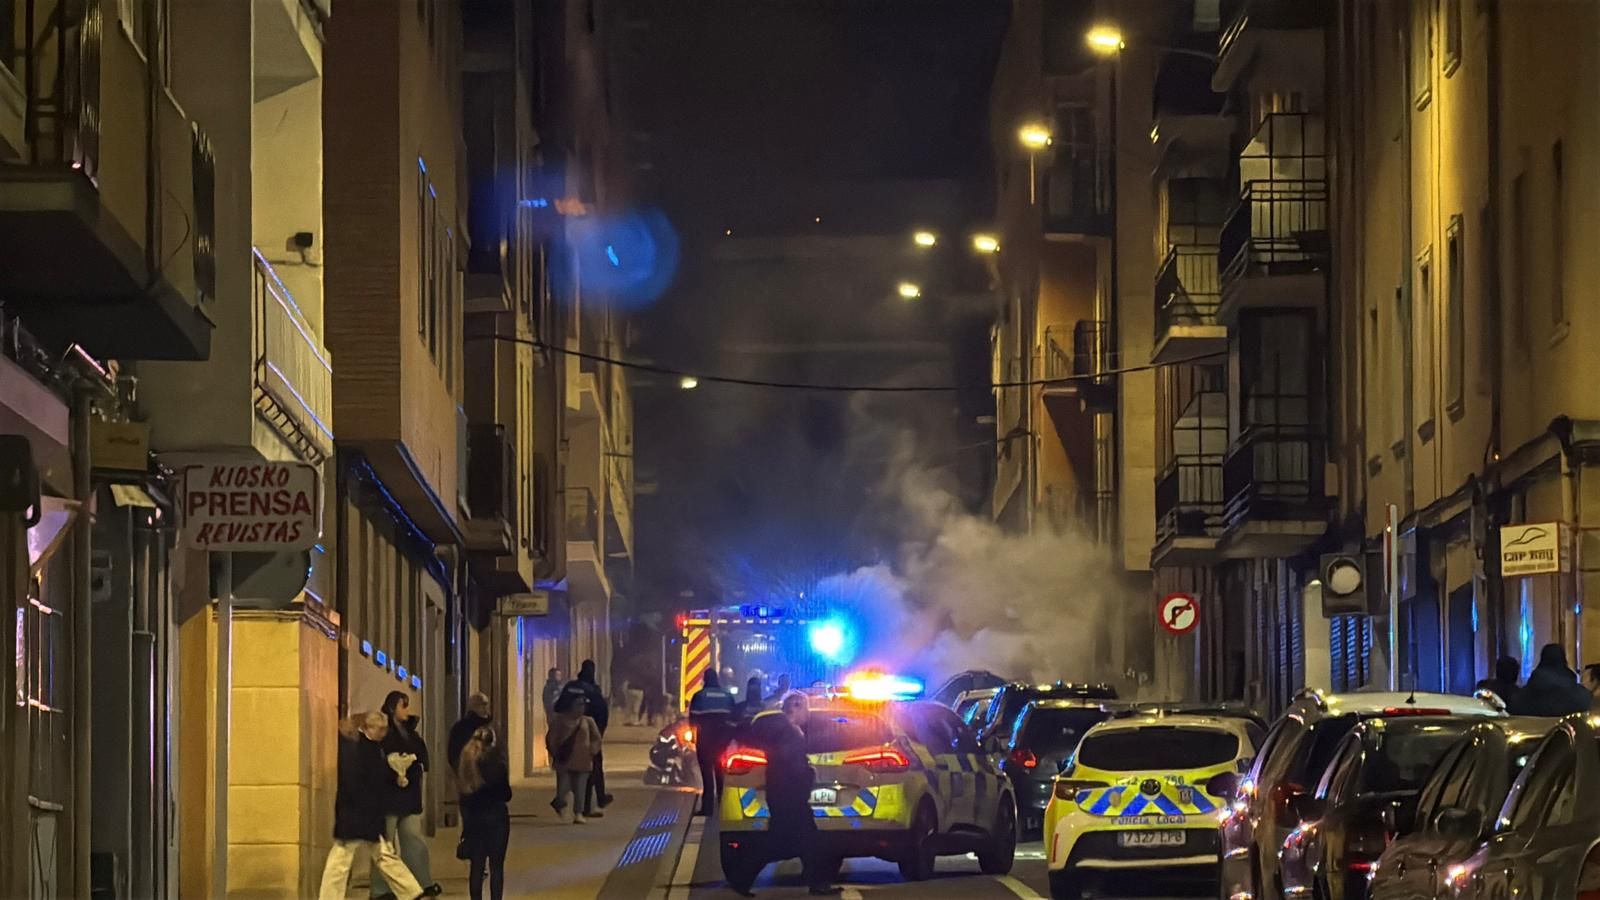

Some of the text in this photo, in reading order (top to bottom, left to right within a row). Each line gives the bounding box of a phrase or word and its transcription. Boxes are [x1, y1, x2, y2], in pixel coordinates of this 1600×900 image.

[209, 464, 290, 488] KIOSKO
[188, 490, 312, 517] PRENSA
[196, 520, 302, 545] REVISTAS
[1156, 815, 1186, 824] Local
